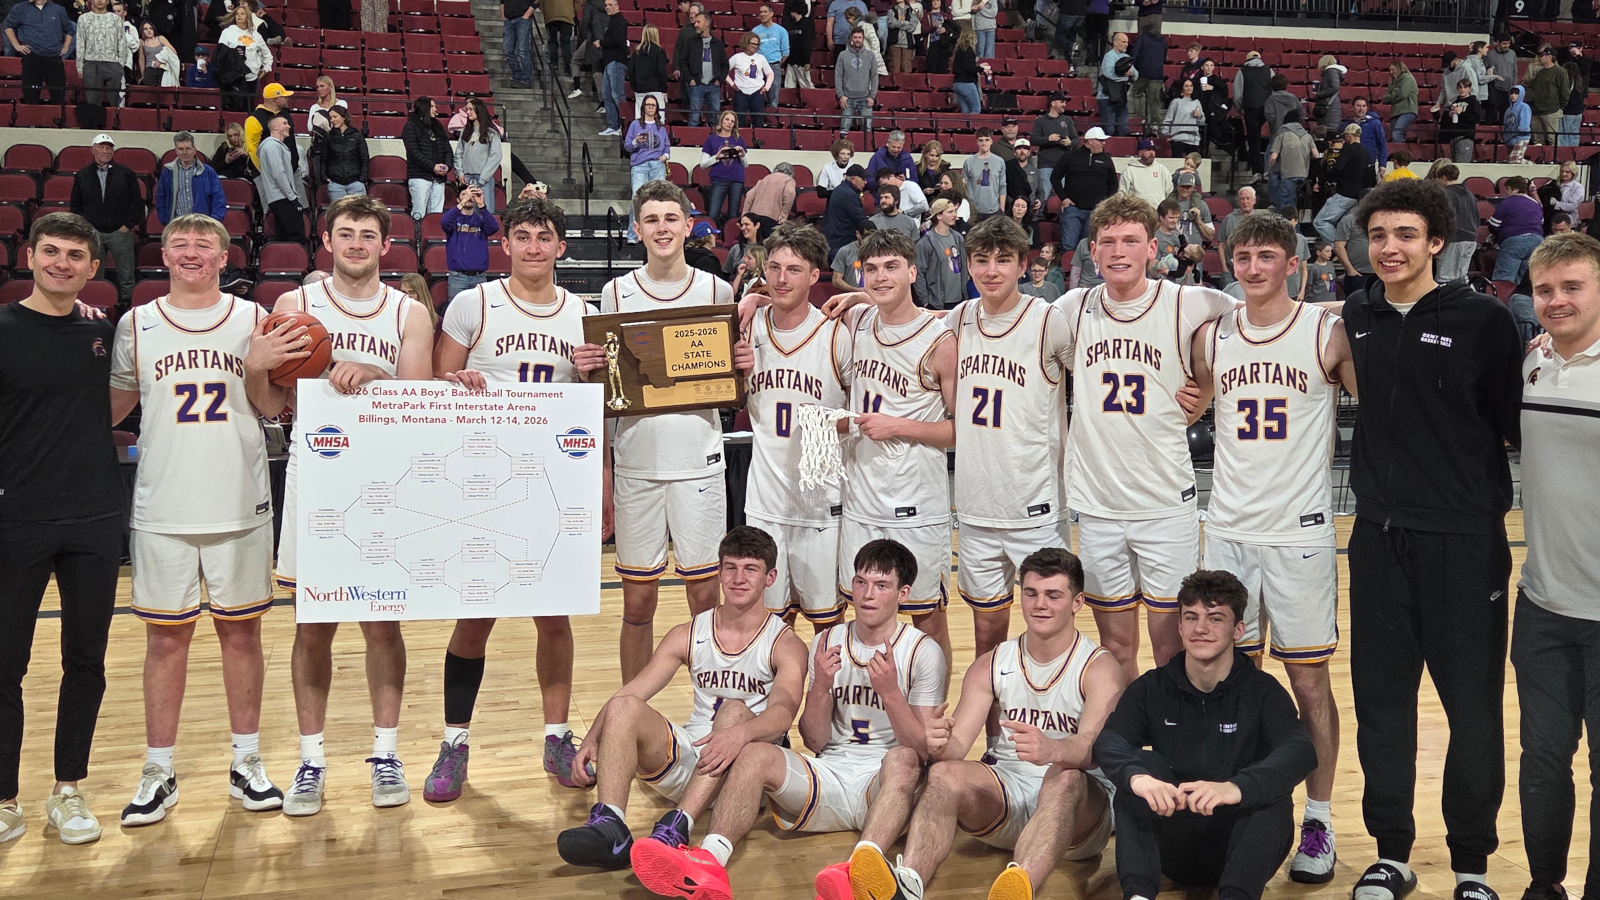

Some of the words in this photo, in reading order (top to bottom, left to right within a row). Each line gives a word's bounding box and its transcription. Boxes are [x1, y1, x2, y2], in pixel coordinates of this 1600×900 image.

[1515, 0, 1525, 13] 9
[674, 327, 718, 338] 2025-2026
[690, 339, 704, 348] AA
[328, 332, 397, 366] PARTANS
[683, 350, 713, 360] STATE
[1086, 338, 1162, 372] SPARTANS
[154, 349, 244, 382] SPARTANS
[671, 360, 727, 372] CHAMPIONS
[960, 353, 1027, 388] SPARTANS
[1220, 361, 1308, 396] SPARTANS
[342, 386, 369, 396] 2026
[371, 387, 398, 396] Class
[401, 388, 417, 396] AA
[451, 388, 503, 398] Basketball
[505, 389, 564, 399] Tournament
[750, 368, 823, 401] SPARTANS
[1101, 371, 1147, 417] 23
[173, 381, 229, 424] 22
[371, 401, 426, 410] MetraPark
[429, 401, 452, 410] First
[455, 402, 504, 411] Interstate
[506, 402, 537, 411] Arena
[971, 385, 1004, 430] 21
[358, 414, 398, 426] Billings,
[401, 415, 447, 424] Montana
[456, 415, 487, 425] March
[490, 416, 520, 426] 12-14,
[523, 416, 549, 425] 2026
[775, 401, 793, 439] 0
[1236, 396, 1289, 442] 35
[313, 436, 350, 448] MHSA
[562, 437, 597, 449] MHSA
[370, 601, 407, 615] Energy
[696, 669, 767, 696] SPARTANS
[849, 717, 872, 745] 5
[1003, 707, 1079, 735] PARTANS
[1364, 873, 1386, 881] PUMA
